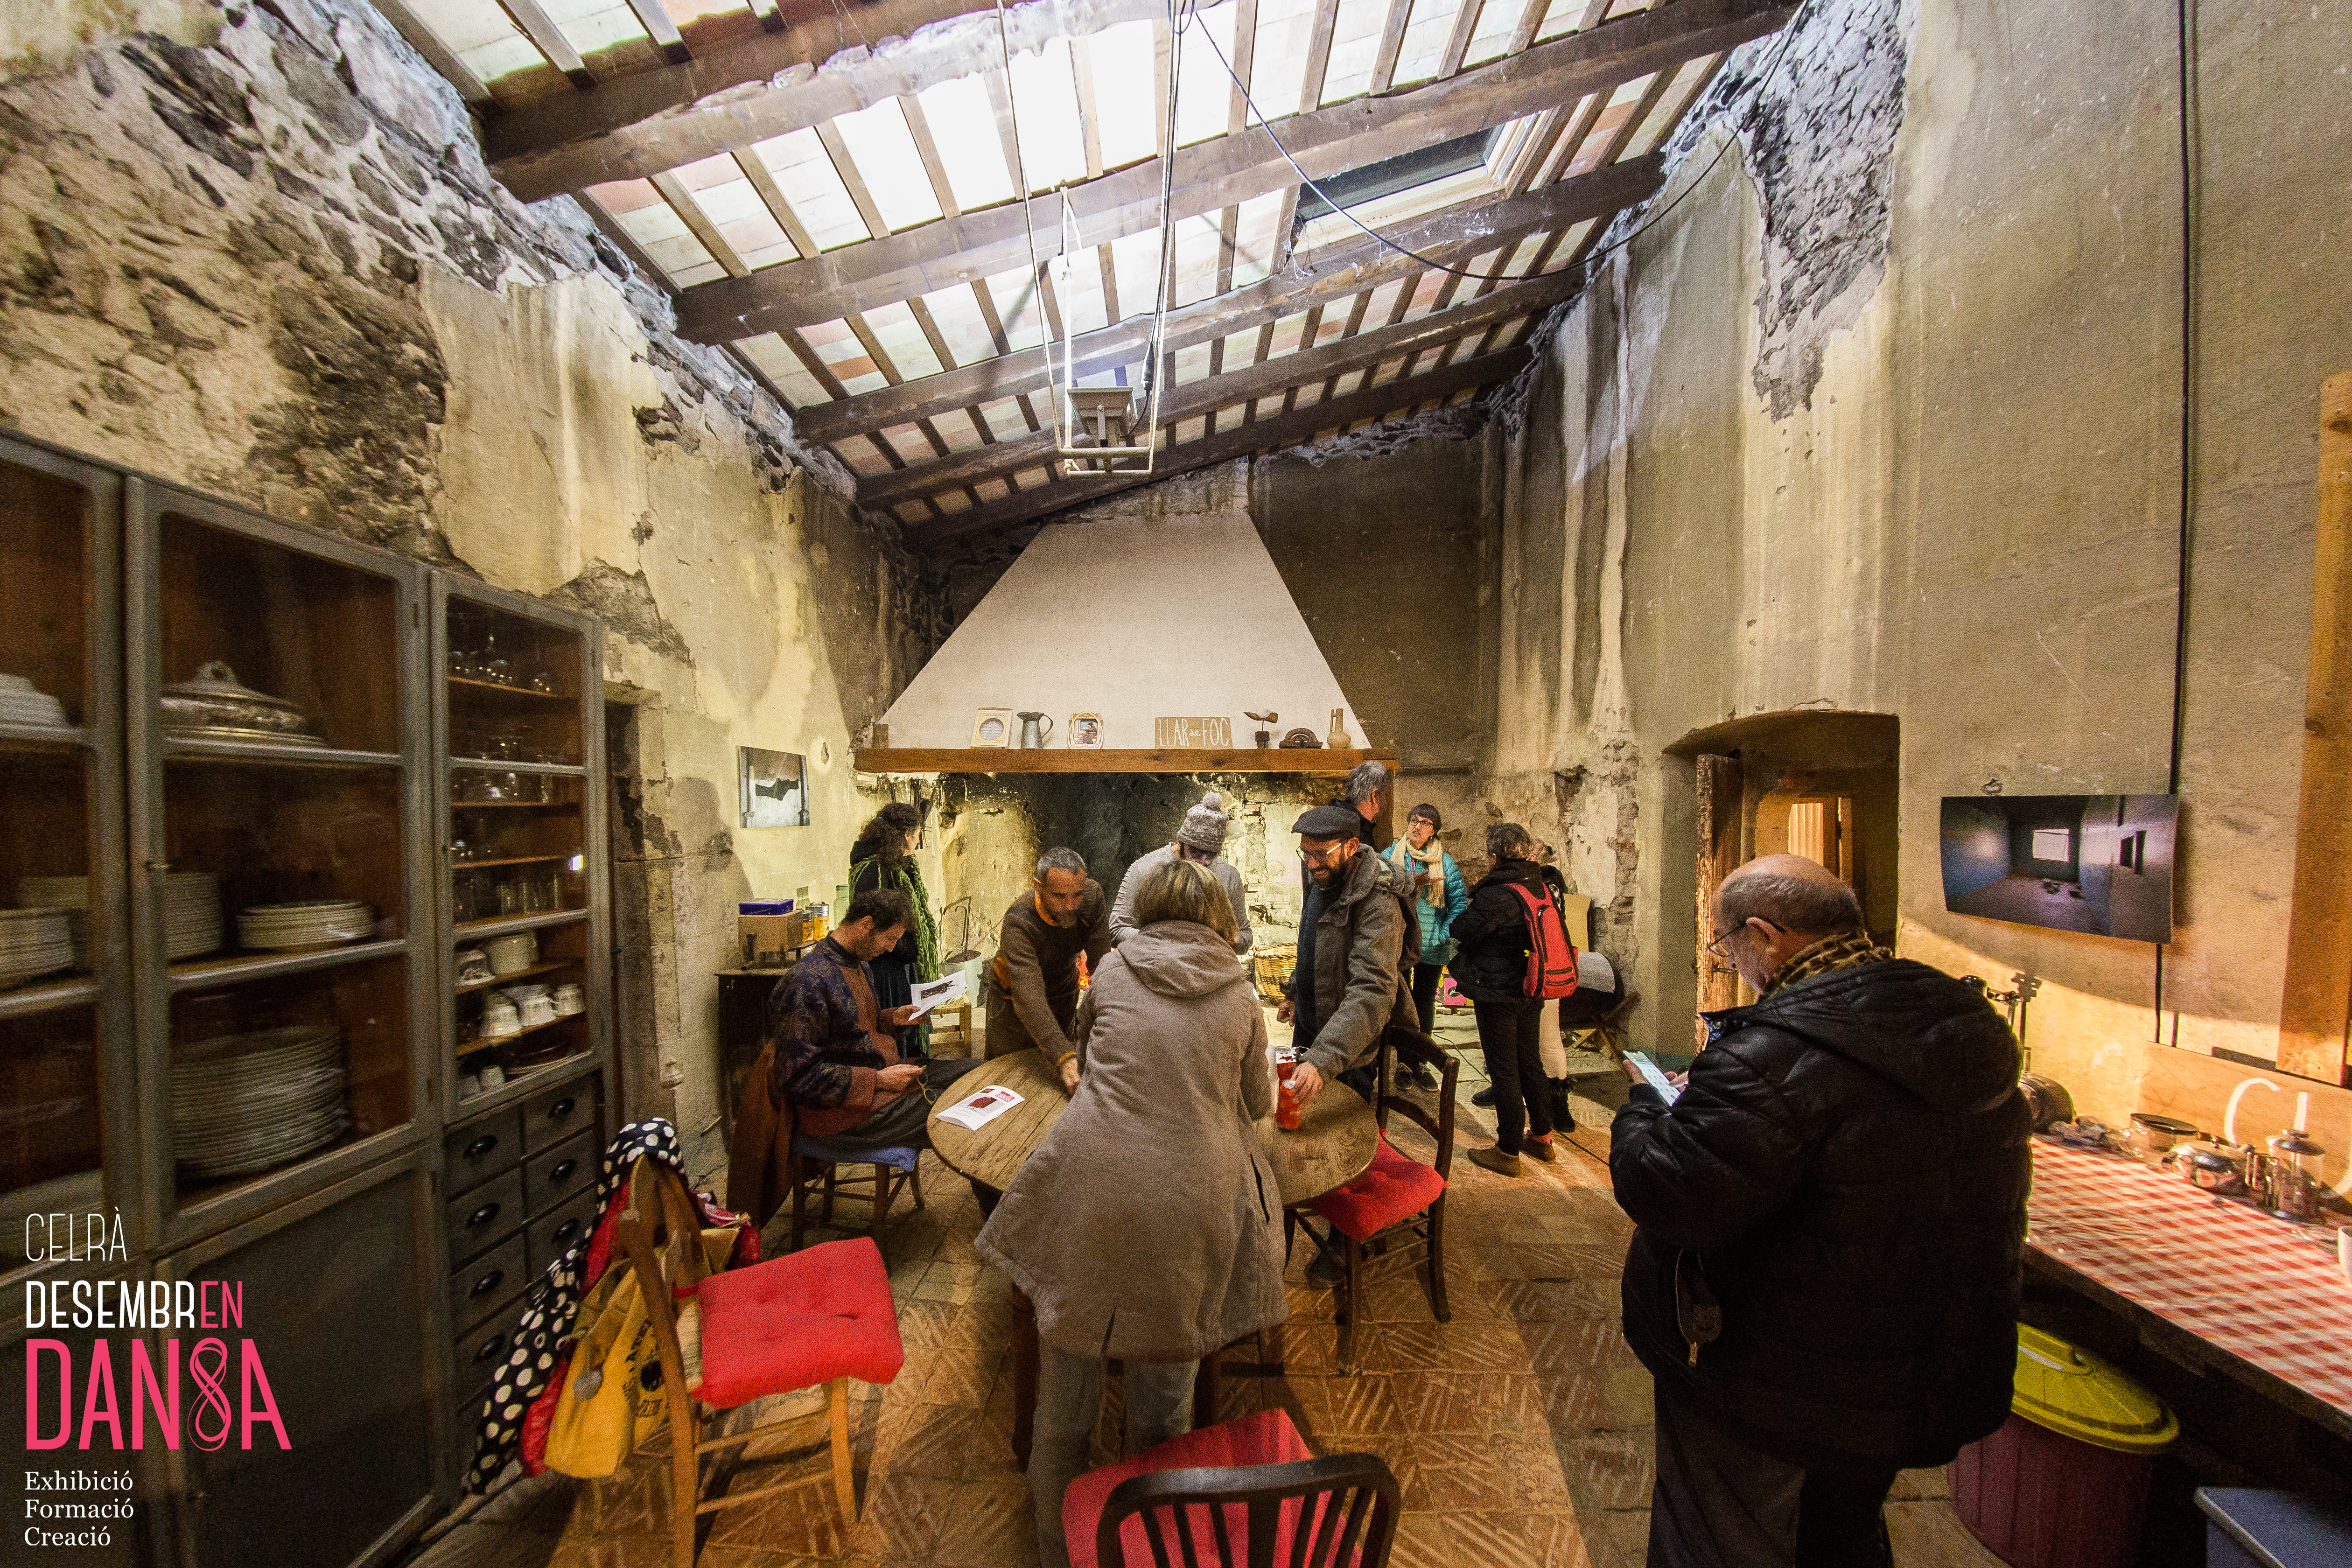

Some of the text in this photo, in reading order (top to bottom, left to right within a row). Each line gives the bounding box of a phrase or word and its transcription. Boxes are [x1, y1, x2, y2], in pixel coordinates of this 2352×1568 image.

[1159, 718, 1229, 747] LLAR de FOC
